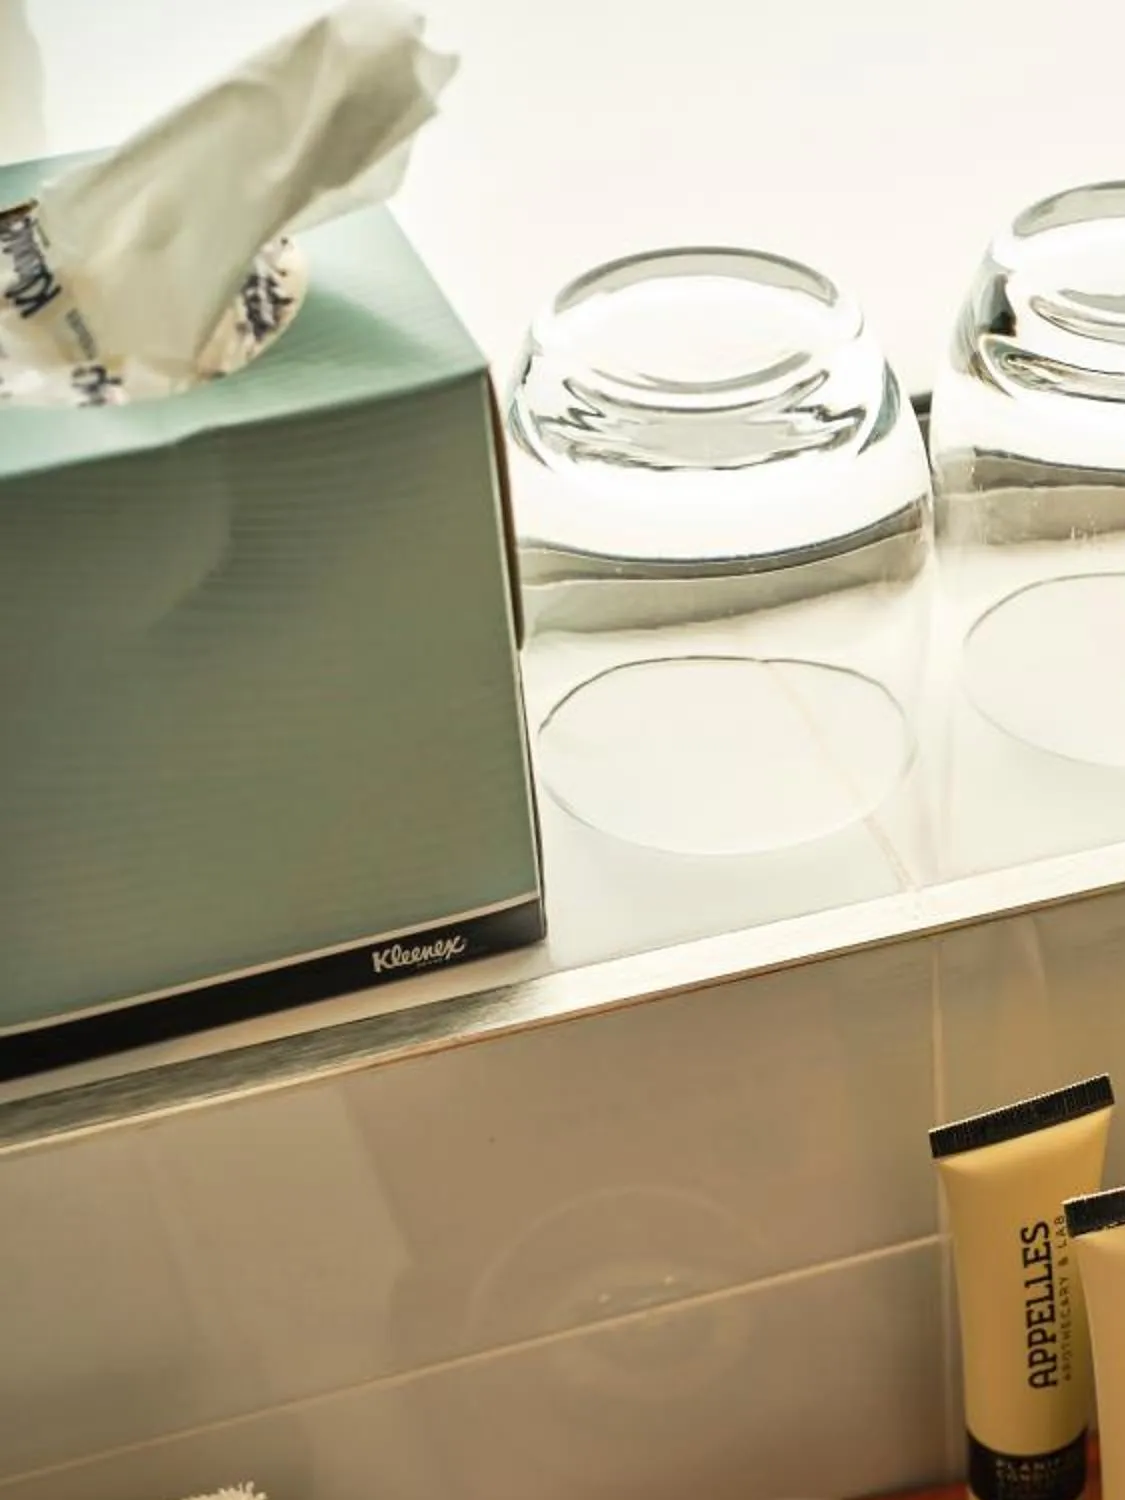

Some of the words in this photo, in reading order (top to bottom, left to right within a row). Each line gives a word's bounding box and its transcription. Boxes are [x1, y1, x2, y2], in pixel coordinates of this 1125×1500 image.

[372, 935, 466, 973] Kleenex
[1053, 1214, 1069, 1249] LAB
[1020, 1220, 1058, 1390] APPELLES
